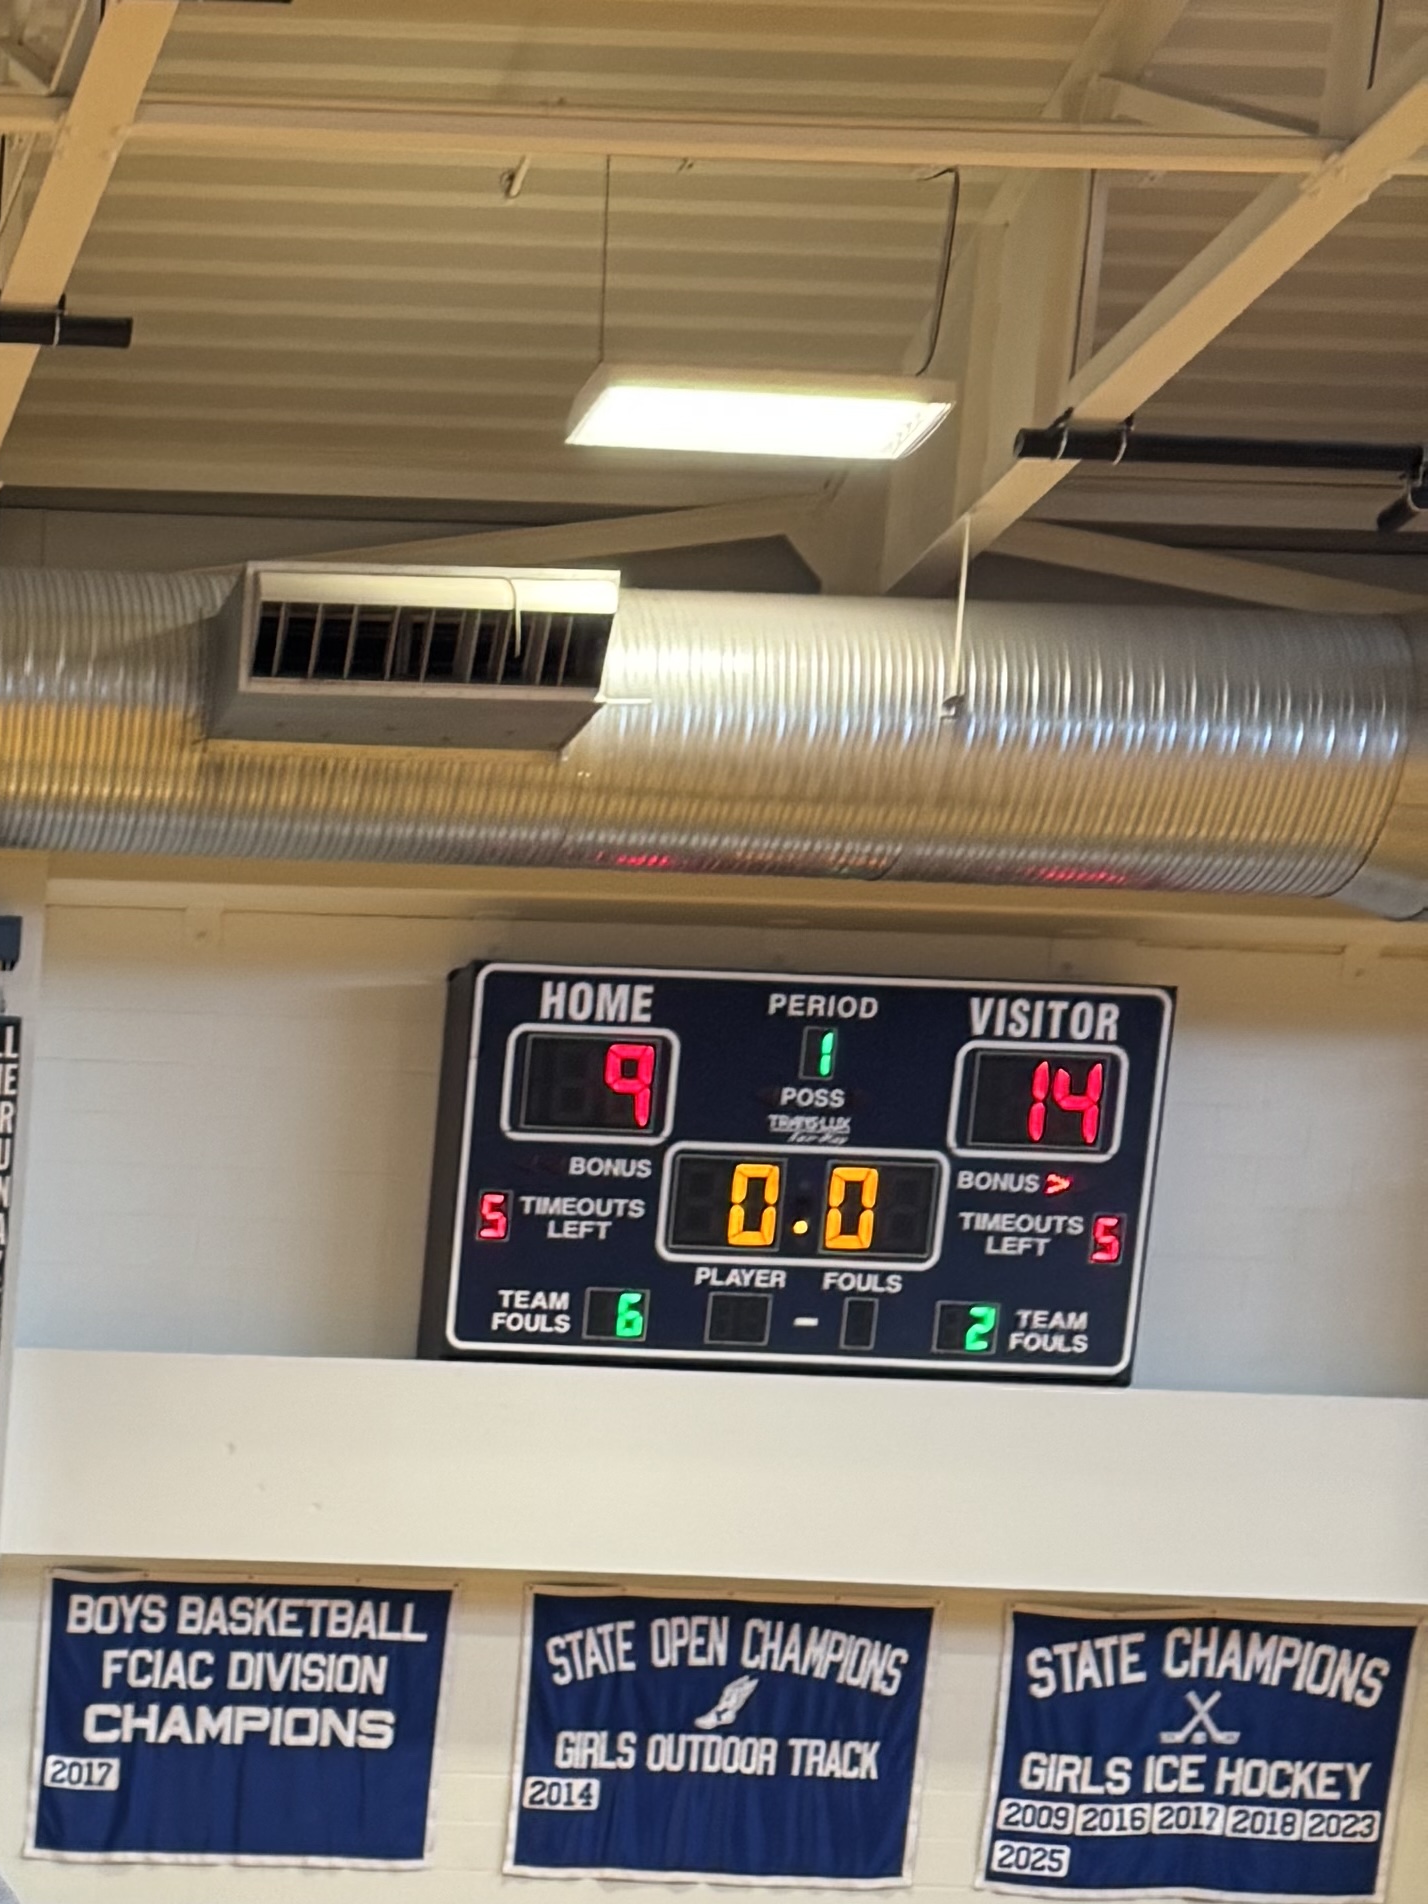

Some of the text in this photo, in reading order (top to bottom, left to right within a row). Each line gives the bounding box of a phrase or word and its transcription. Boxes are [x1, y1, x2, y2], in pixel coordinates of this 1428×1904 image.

[539, 981, 655, 1024] HOME
[769, 993, 879, 1020] PERIOD
[969, 997, 1120, 1042] VISITOR
[819, 1031, 834, 1076] 1
[605, 1043, 655, 1128] 9
[780, 1088, 845, 1109] POSS
[1027, 1061, 1103, 1144] 14
[568, 1157, 652, 1178] BONUS
[957, 1171, 1040, 1193] BONUS
[479, 1193, 646, 1238] 5 TIMEOUTS
[727, 1163, 879, 1249] 0.0
[958, 1211, 1084, 1235] TIMEOUTS
[546, 1220, 612, 1241] LEFT
[985, 1236, 1052, 1256] LEFT
[1091, 1216, 1121, 1262] 5
[498, 1289, 570, 1311] TEAM
[695, 1267, 902, 1294] PLAYER FOULS
[491, 1312, 571, 1334] FOULS
[616, 1292, 643, 1338] 6
[965, 1306, 996, 1350] 2
[1016, 1309, 1088, 1331] TEAM
[1008, 1332, 1088, 1353] FOULS
[66, 1594, 428, 1642] BOYS BASKETBALL
[102, 1649, 388, 1695] FCIAC DIVISION
[546, 1616, 909, 1696] STATE OPEN CHAMPIONS
[1026, 1626, 1391, 1708] STATE CHAMPIONS
[83, 1704, 396, 1750] CHAMPIONS
[50, 1759, 113, 1786] 2017
[555, 1730, 881, 1780] GIRLS OUTDOOR TRACK
[1019, 1751, 1372, 1801] GIRLS ICE HOCKEY
[529, 1780, 594, 1807] 2014
[1003, 1802, 1375, 1838] 2009 2016 2017 2018 2023
[996, 1844, 1065, 1872] 2025
